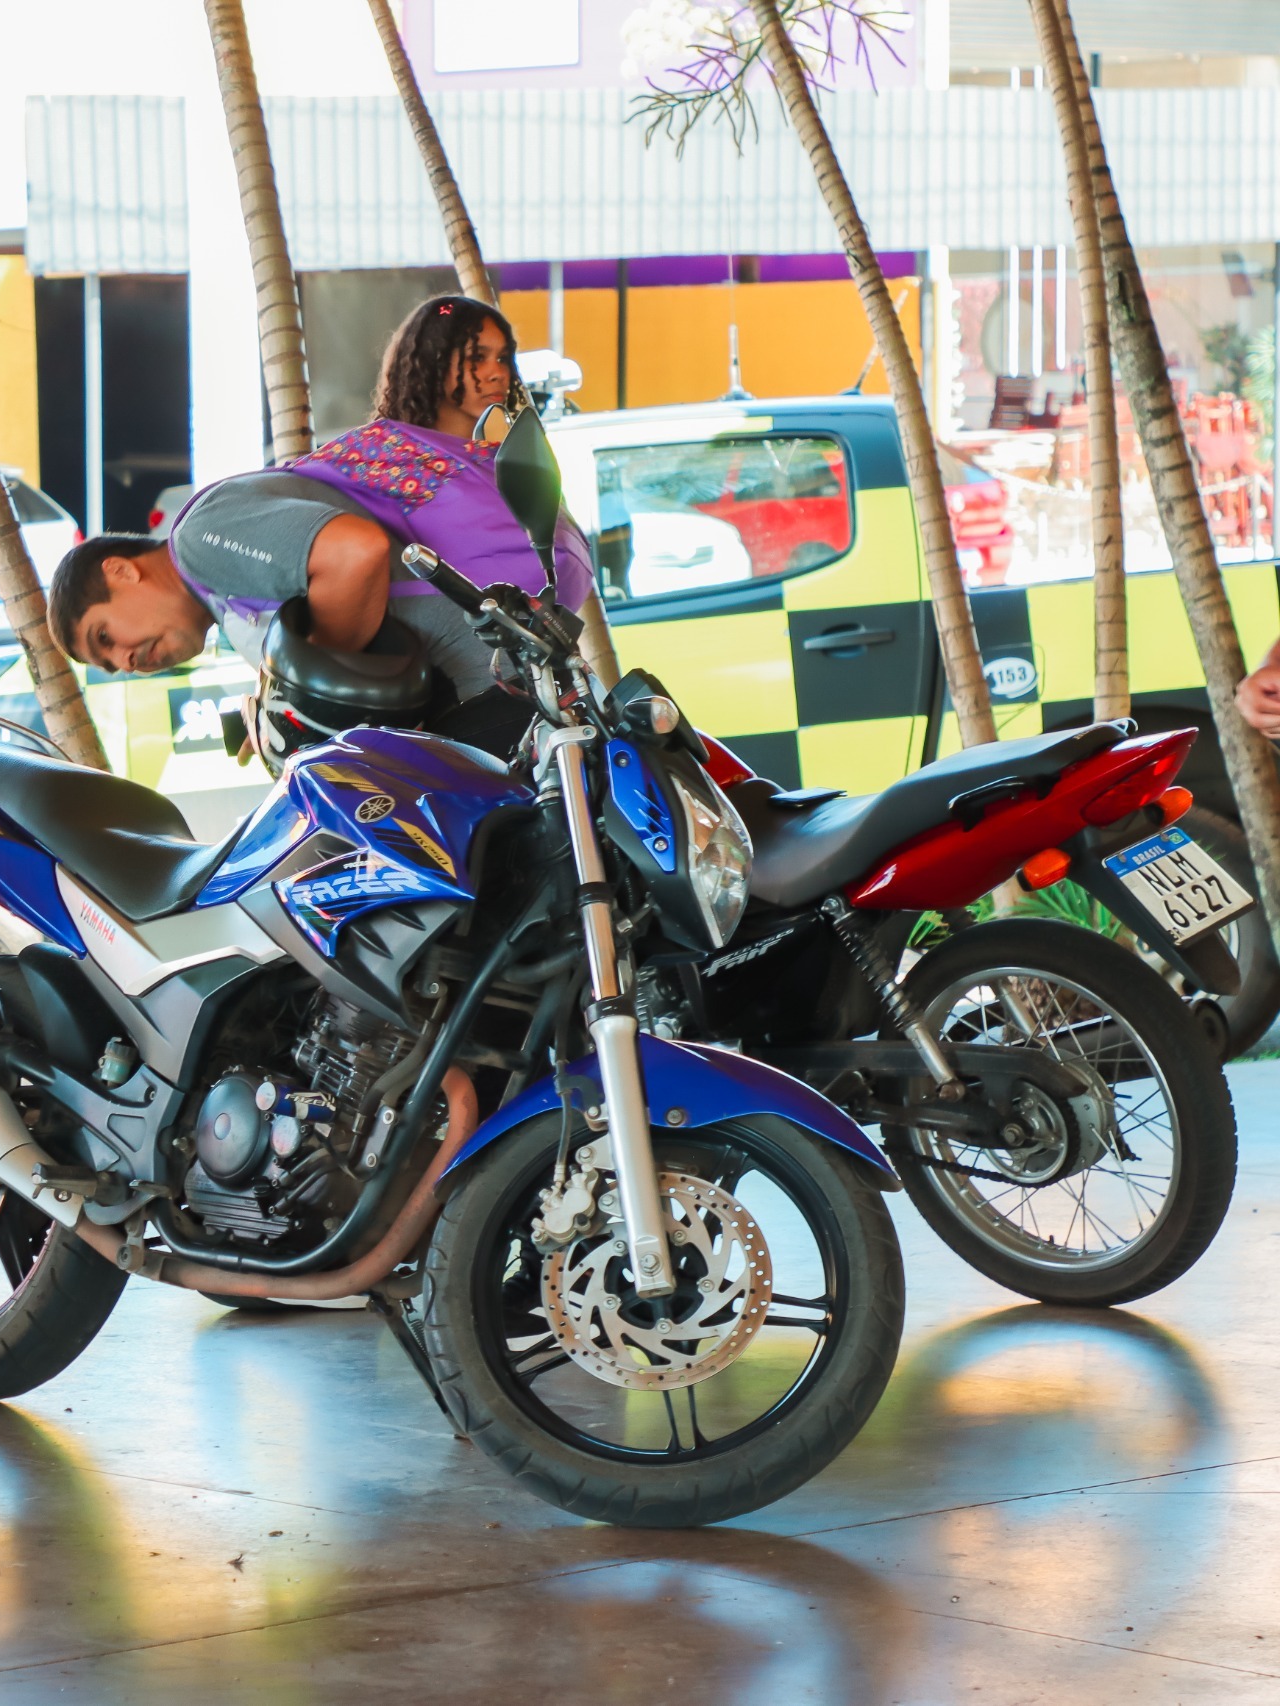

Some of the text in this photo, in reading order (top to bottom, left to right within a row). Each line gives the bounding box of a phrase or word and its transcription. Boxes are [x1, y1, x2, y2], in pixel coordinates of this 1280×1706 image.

[1131, 845, 1166, 866] BRASIL
[1136, 851, 1202, 896] NLM
[290, 871, 431, 905] FAZER
[80, 901, 116, 944] YAMAHA
